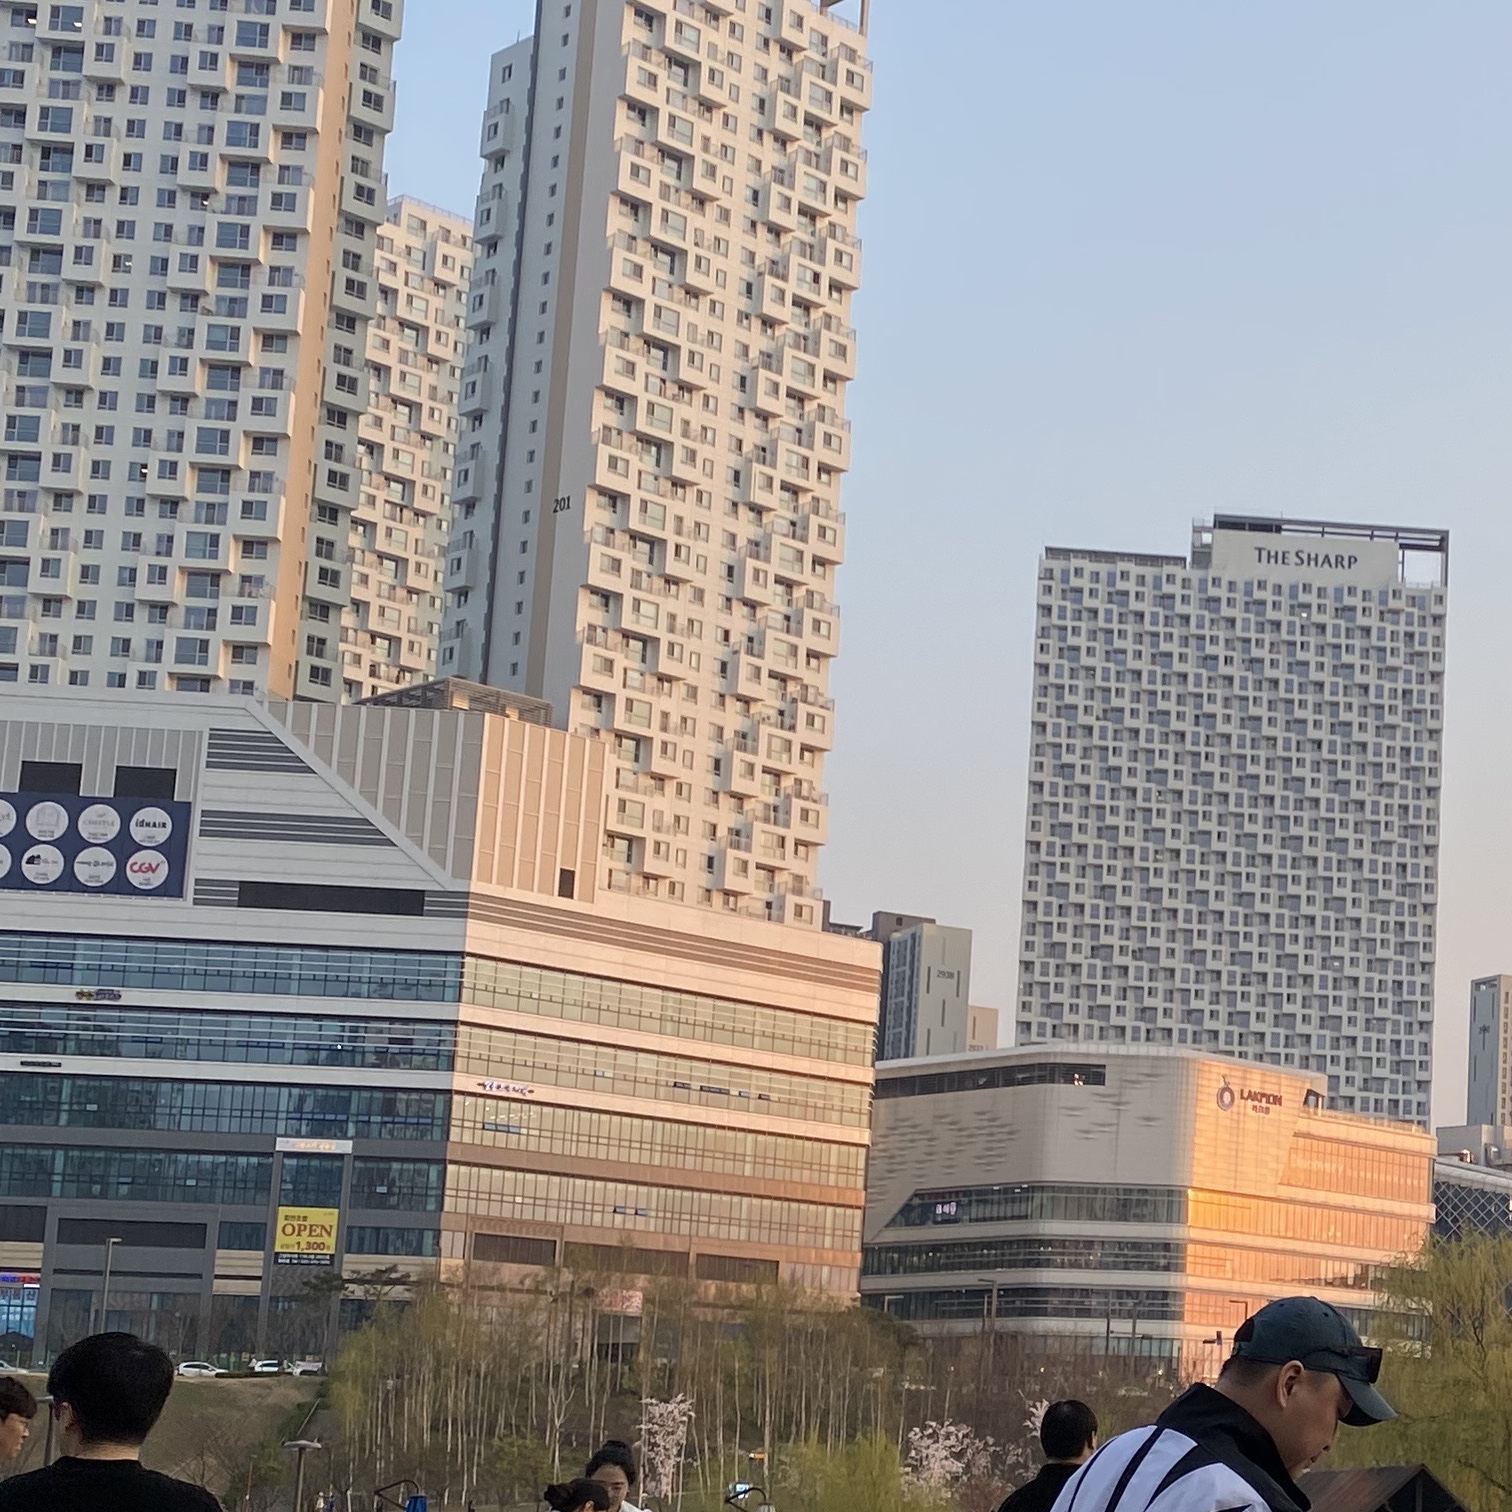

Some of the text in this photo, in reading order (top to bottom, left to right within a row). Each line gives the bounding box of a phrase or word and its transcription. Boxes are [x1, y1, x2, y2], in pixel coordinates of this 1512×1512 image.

[553, 495, 571, 514] 201
[1254, 546, 1358, 571] THE SHARP
[129, 861, 160, 875] CGV
[281, 1222, 334, 1239] OPEN
